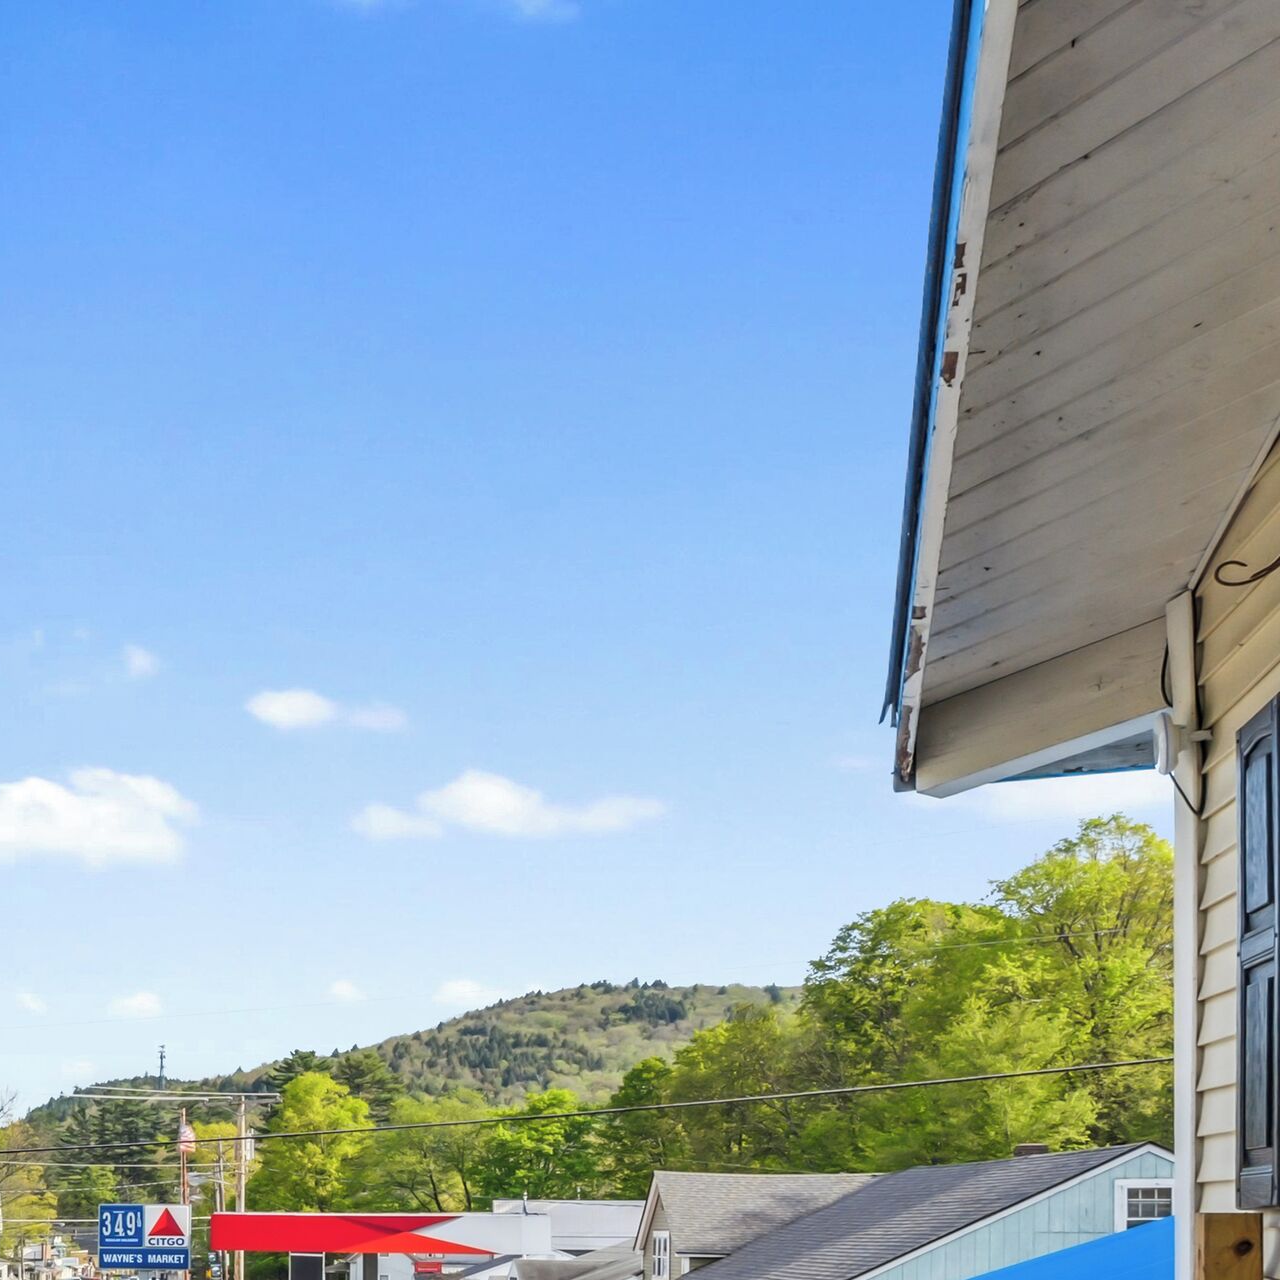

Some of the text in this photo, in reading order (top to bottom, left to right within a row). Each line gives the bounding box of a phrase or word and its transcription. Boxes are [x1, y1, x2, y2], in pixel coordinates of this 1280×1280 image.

[148, 1237, 185, 1246] CITGO
[102, 1253, 185, 1264] WAYNE'S MARKET
